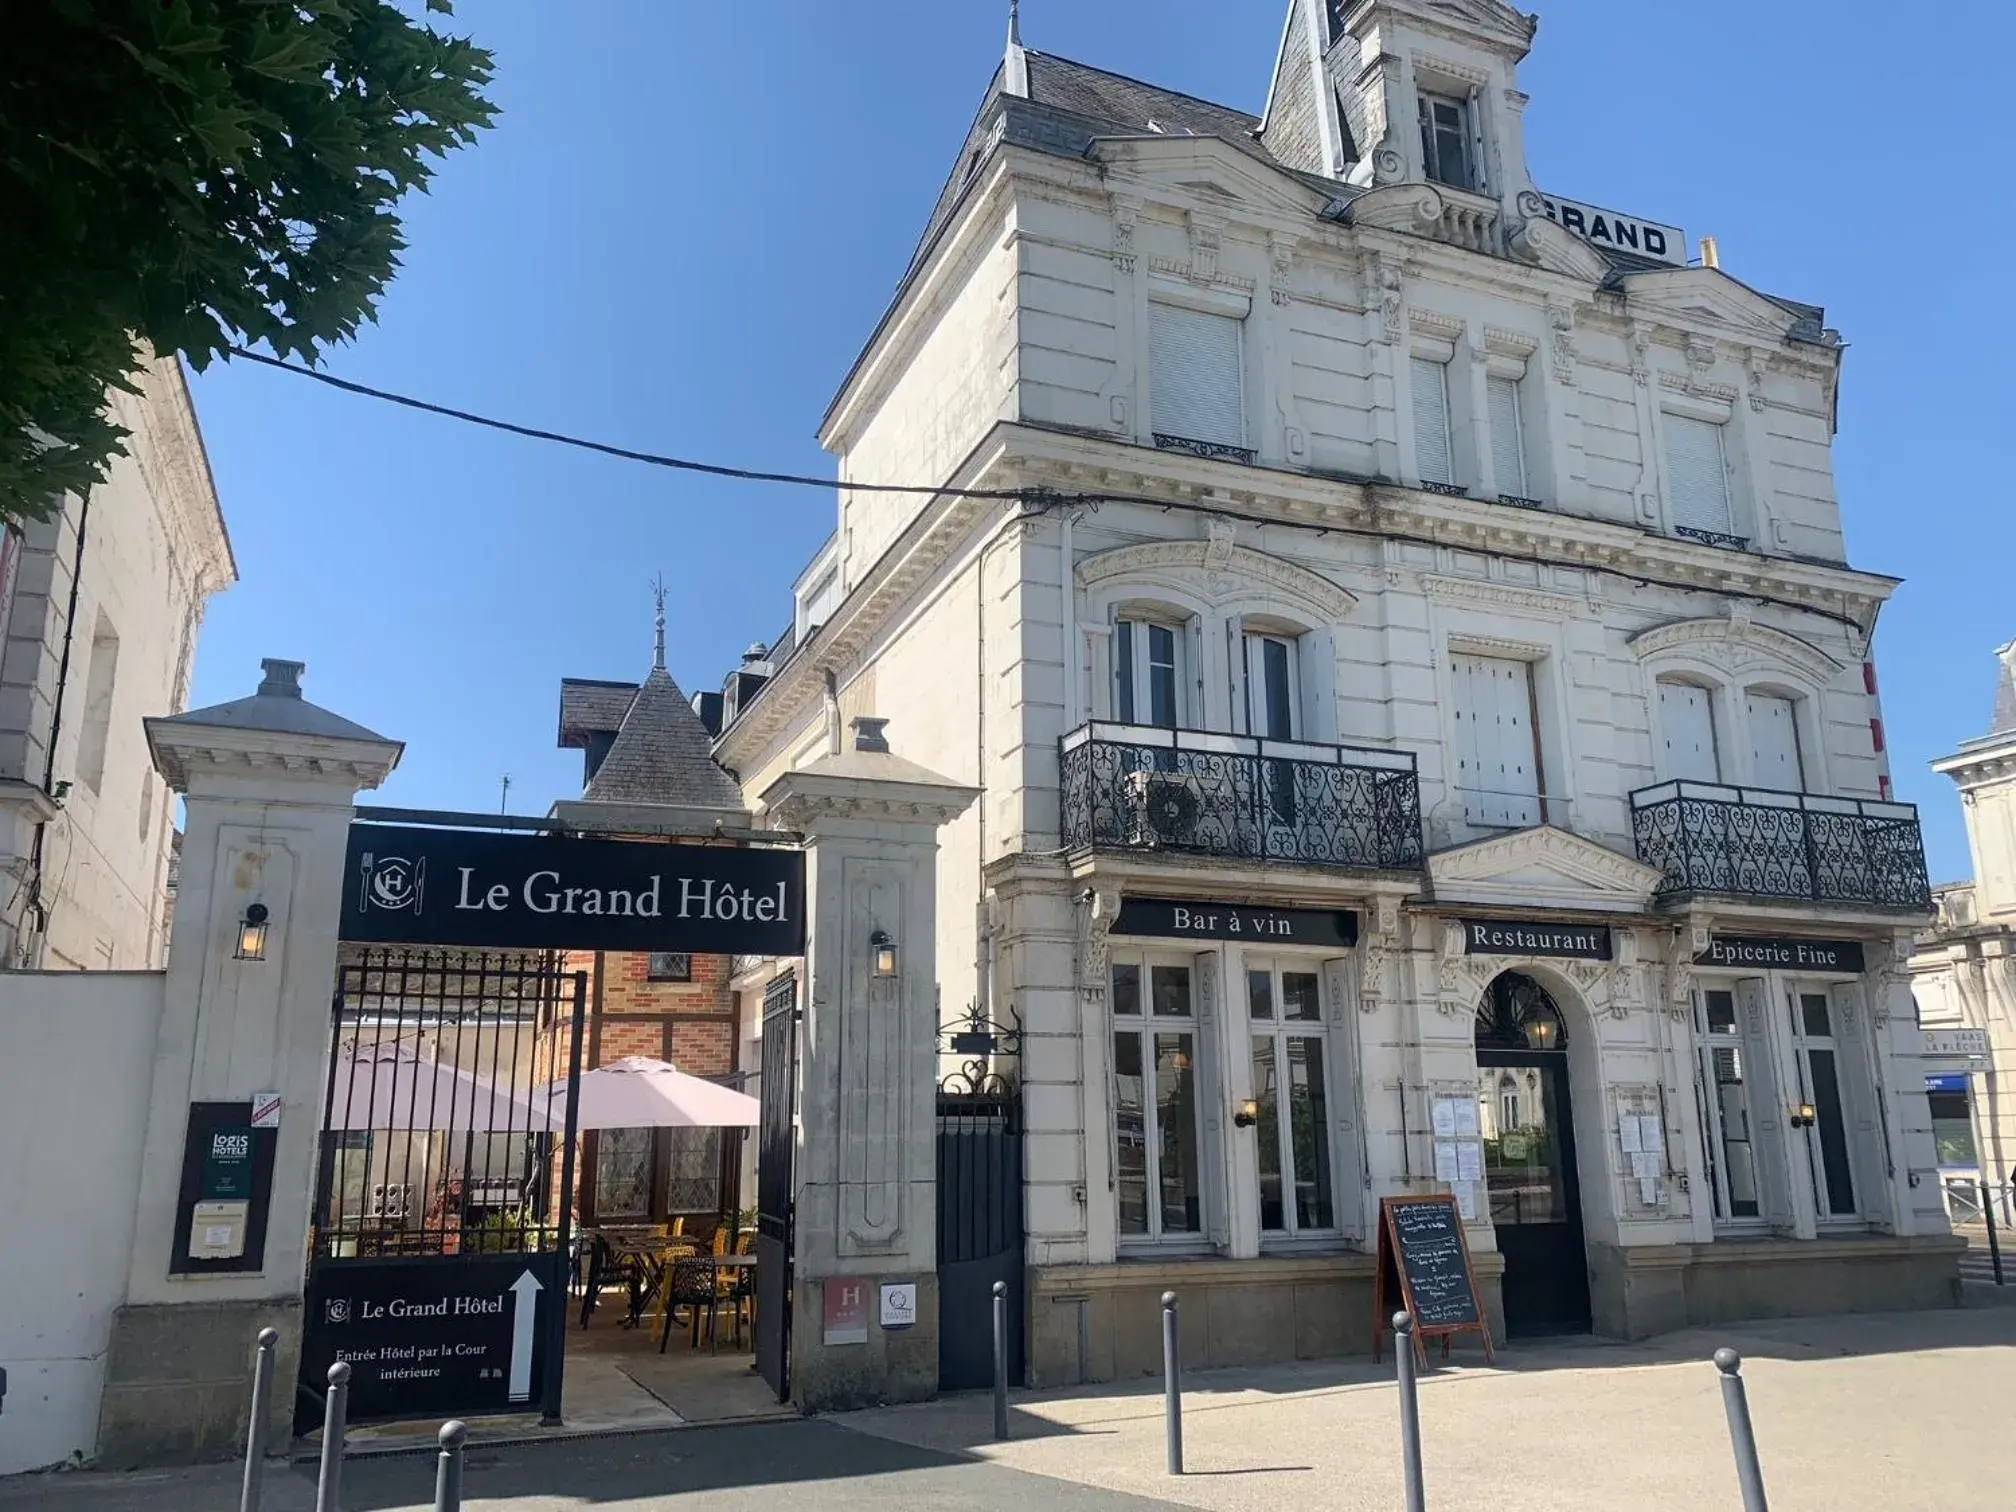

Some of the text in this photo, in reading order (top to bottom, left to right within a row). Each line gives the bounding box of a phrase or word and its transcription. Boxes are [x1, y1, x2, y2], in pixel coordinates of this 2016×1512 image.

[454, 866, 790, 923] Le Grand Hôtel
[1173, 908, 1293, 935] Bar à vin
[1471, 924, 1599, 951] Restaurant
[1711, 940, 1838, 965] Epicerie Fine
[361, 1295, 504, 1318] Le Grand Hôtel
[842, 1287, 860, 1306] H
[335, 1344, 487, 1362] Entrée Hôtel par la Cour
[380, 1367, 441, 1380] intérieure
